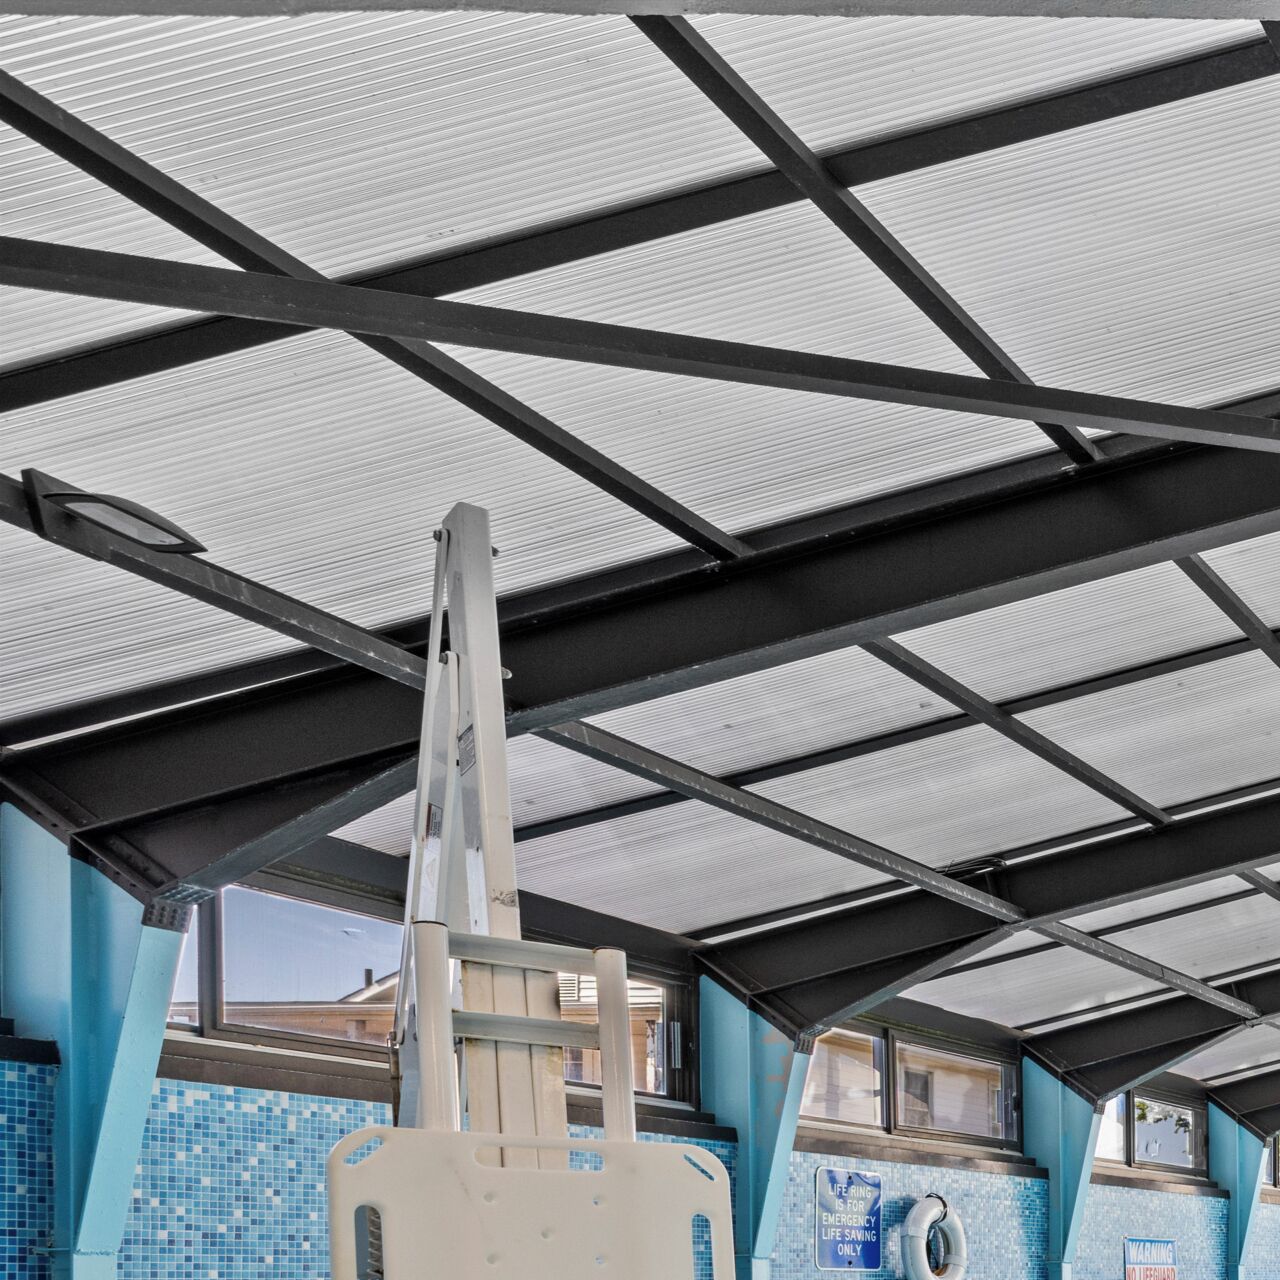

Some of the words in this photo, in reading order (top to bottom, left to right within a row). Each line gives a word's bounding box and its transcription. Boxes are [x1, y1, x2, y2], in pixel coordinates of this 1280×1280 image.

[828, 1183, 848, 1196] LIFE
[850, 1185, 871, 1198] RING
[835, 1199, 844, 1210] IS
[847, 1200, 865, 1212] FOR
[822, 1213, 876, 1227] EMERGENCY
[822, 1228, 842, 1241] LIFE
[844, 1229, 876, 1242] SAVING
[837, 1243, 862, 1256] ONLY
[1129, 1241, 1173, 1264] WARNING
